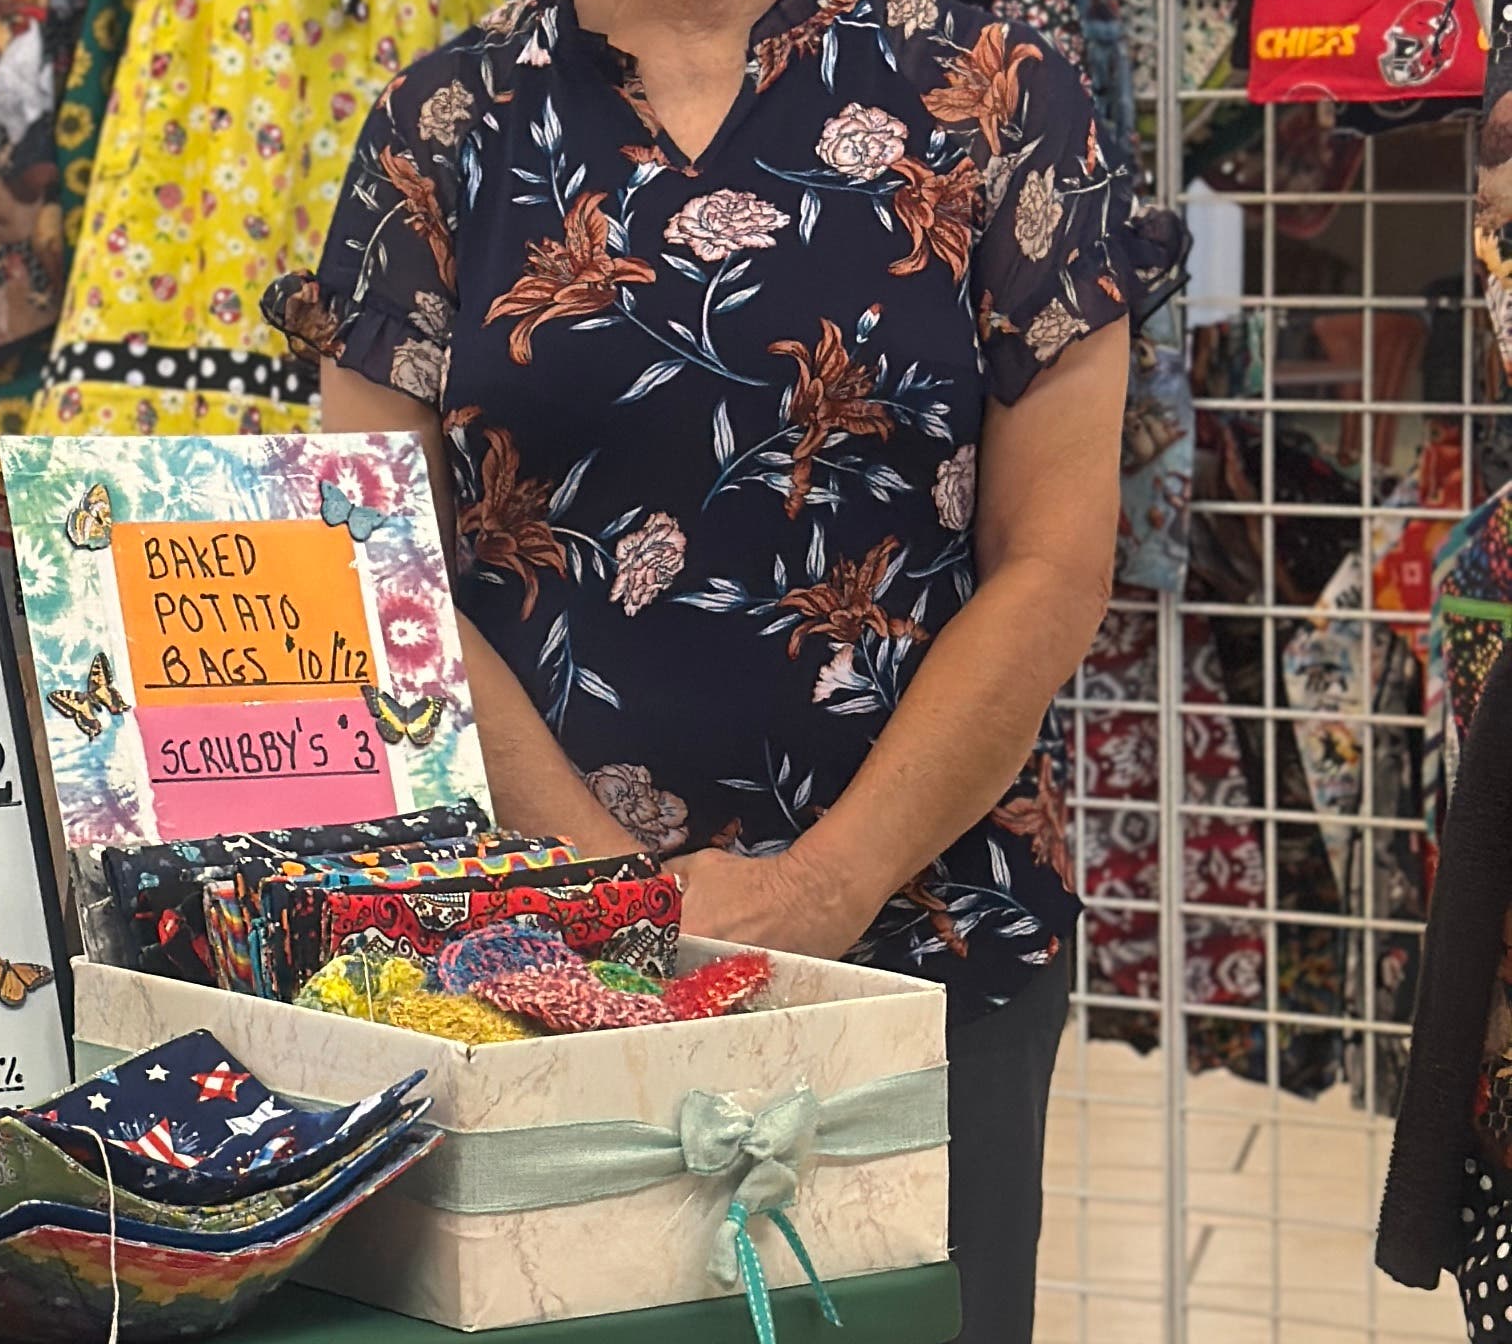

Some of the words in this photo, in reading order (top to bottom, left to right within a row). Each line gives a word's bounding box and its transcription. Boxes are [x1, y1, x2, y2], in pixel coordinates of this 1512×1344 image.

[1256, 25, 1360, 59] CHIEFS
[145, 533, 256, 580] BAKED
[154, 592, 300, 635] POTATO
[162, 645, 267, 685] BAGS
[161, 717, 328, 775] SCRUBBY'S
